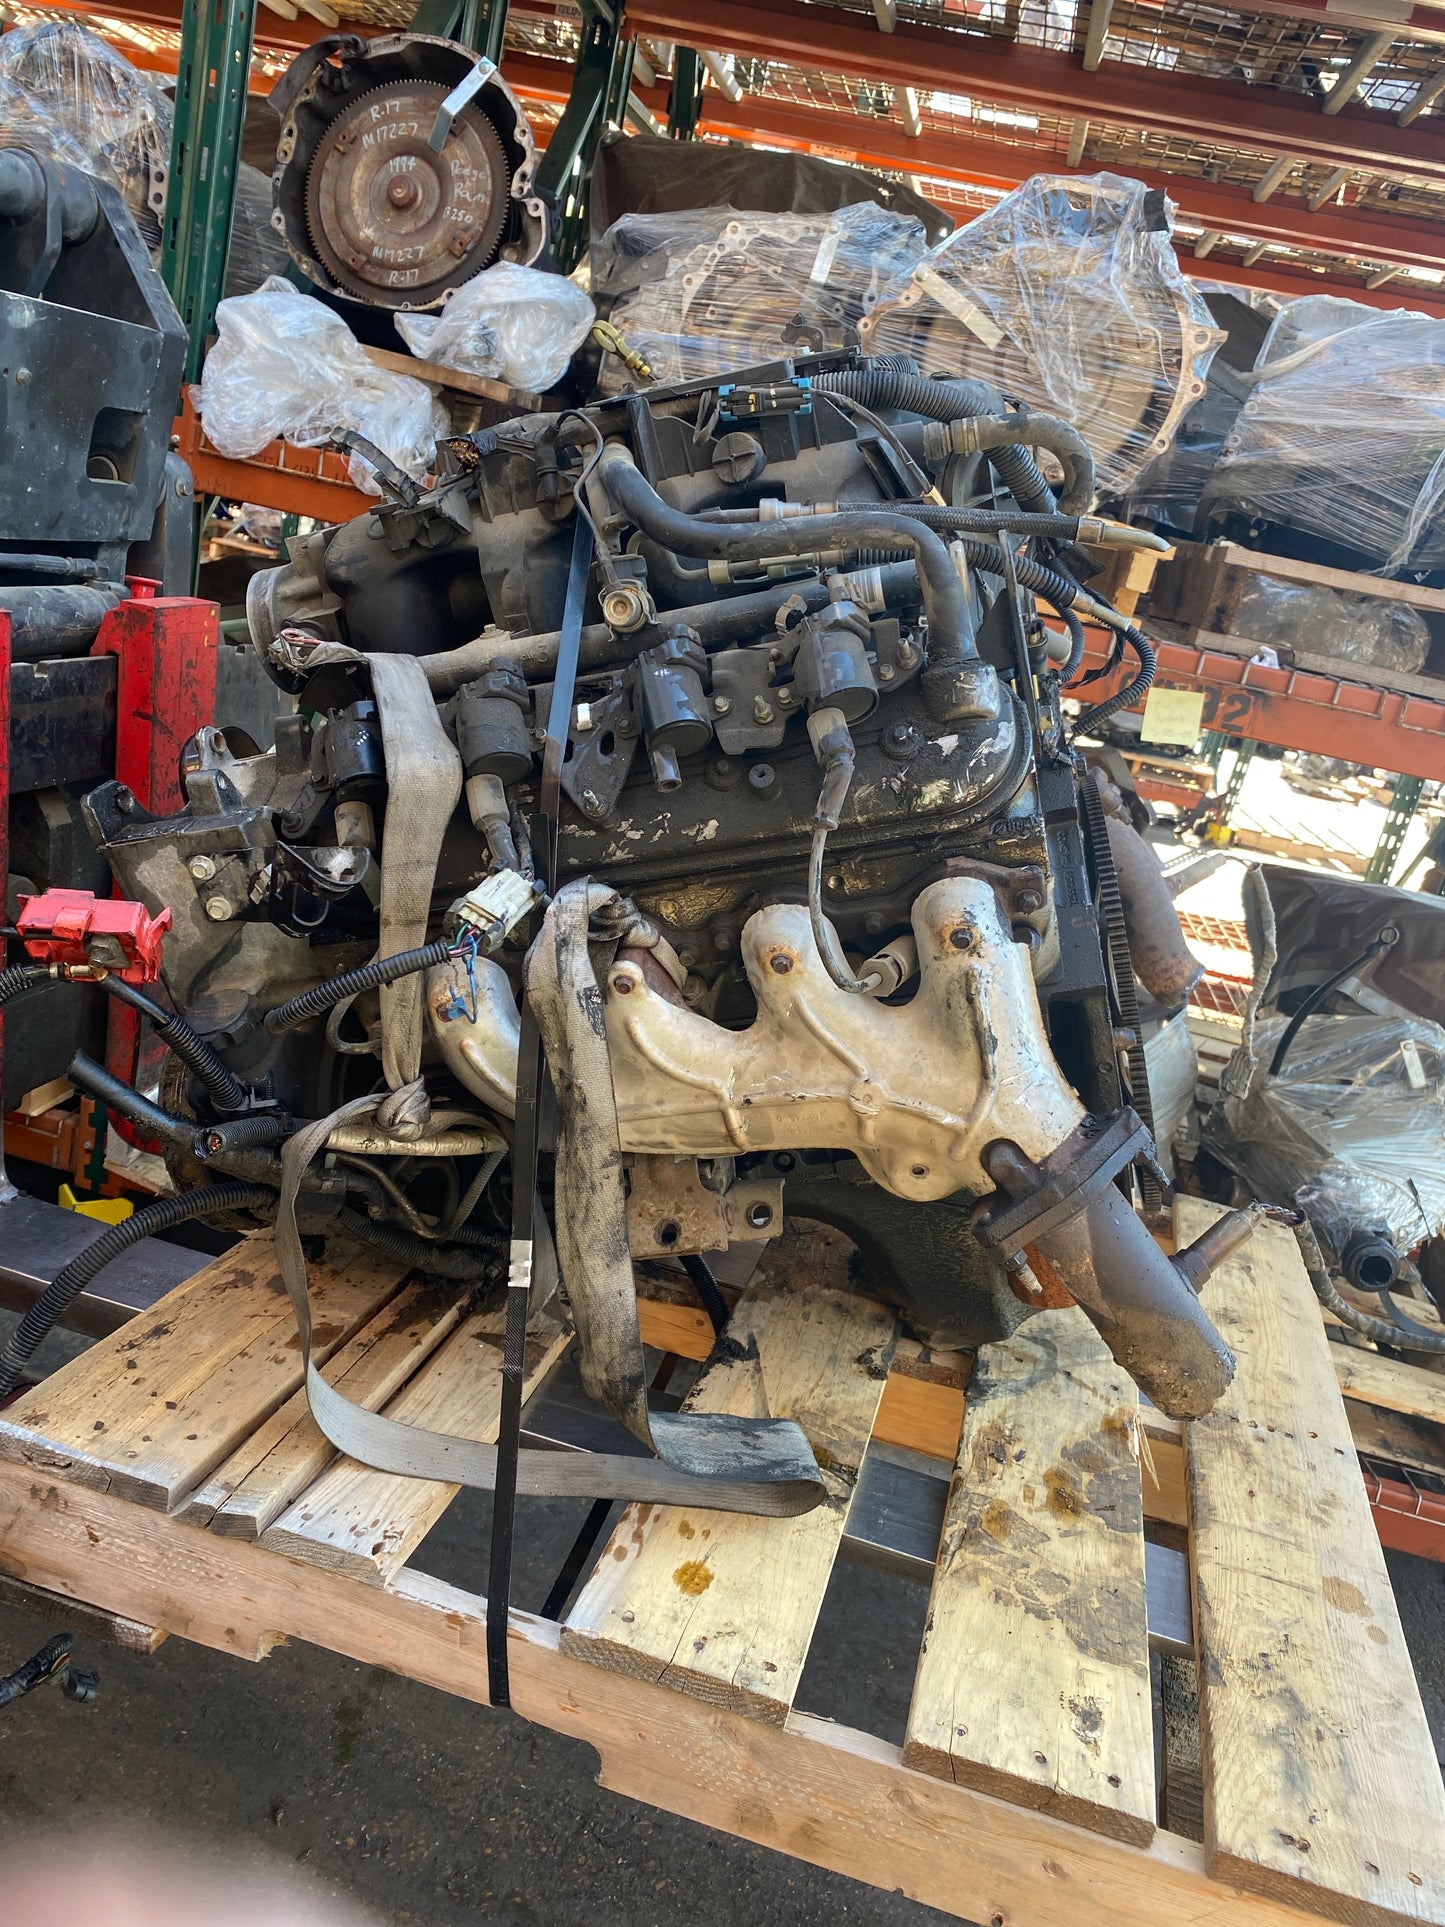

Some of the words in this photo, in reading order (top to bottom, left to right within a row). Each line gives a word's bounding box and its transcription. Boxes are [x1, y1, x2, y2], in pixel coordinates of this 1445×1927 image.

[362, 122, 418, 149] M17227
[389, 156, 416, 173] 1994
[372, 245, 425, 263] M17227
